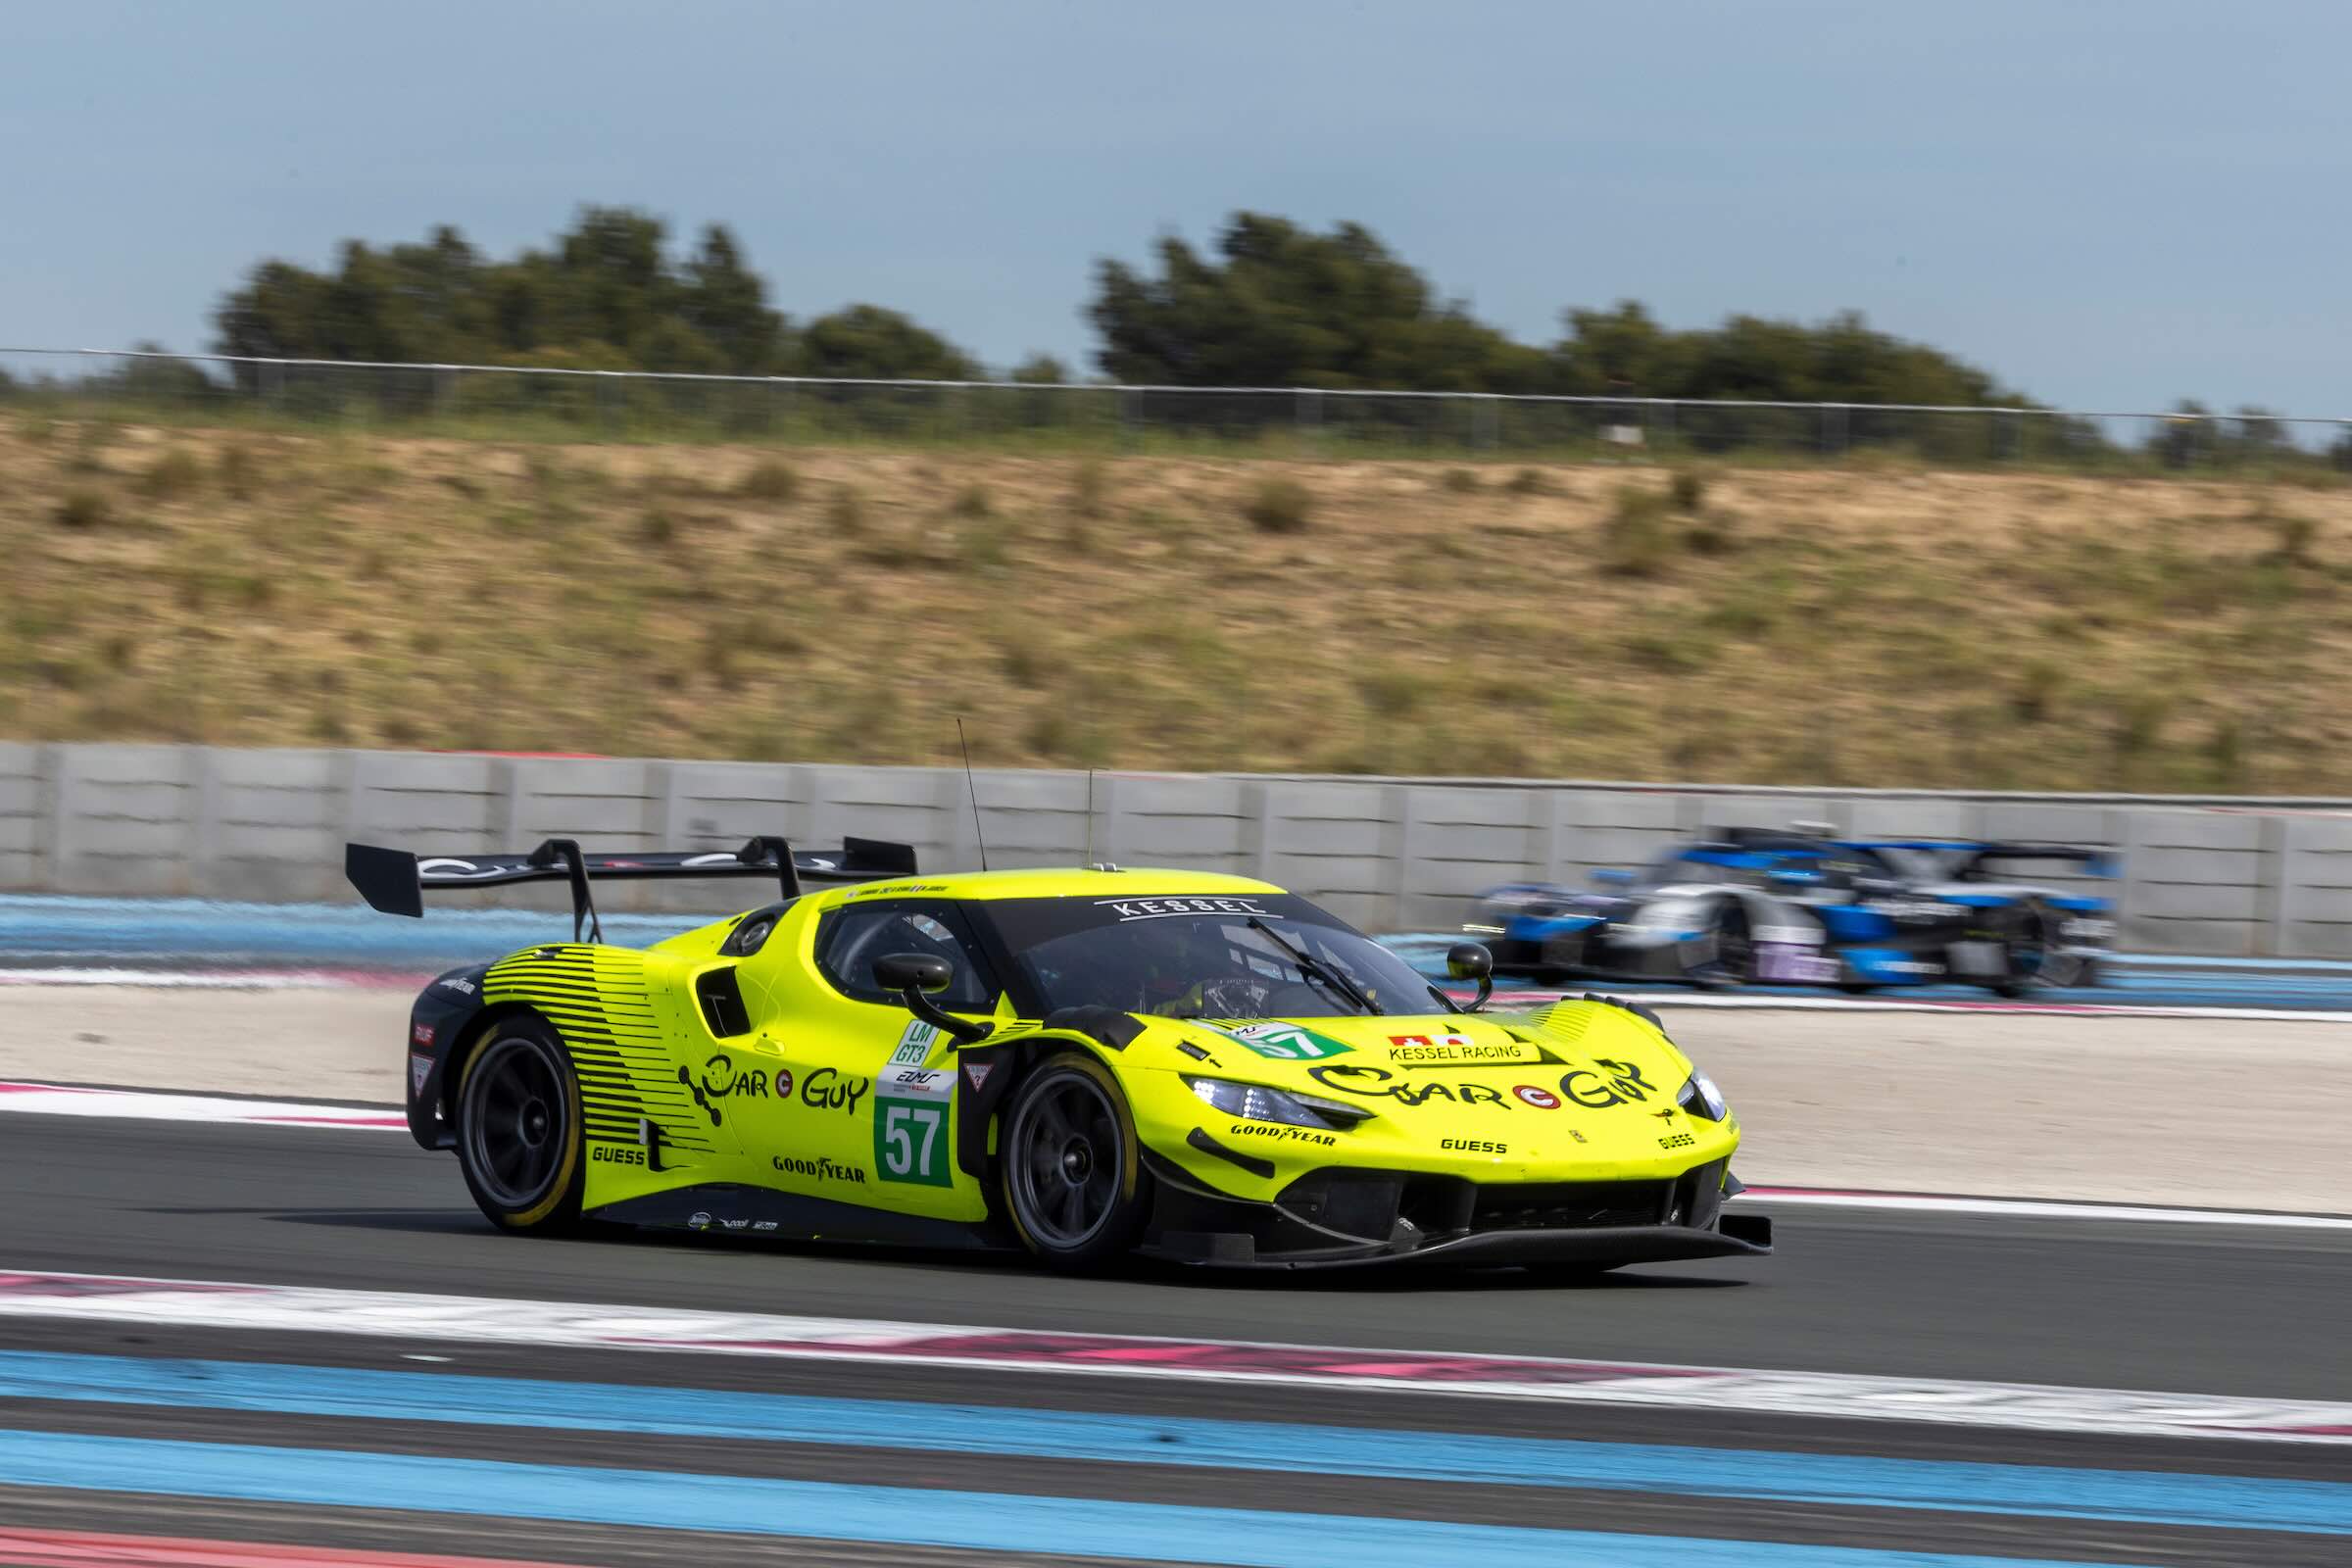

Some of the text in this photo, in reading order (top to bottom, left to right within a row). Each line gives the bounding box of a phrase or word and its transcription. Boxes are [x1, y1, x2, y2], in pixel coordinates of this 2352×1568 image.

[1112, 899, 1267, 916] KESSEL
[909, 1023, 934, 1043] LM
[896, 1045, 926, 1063] GT3
[1389, 1046, 1522, 1060] KESSEL RACING
[886, 1105, 942, 1176] 57
[1441, 1139, 1507, 1153] GUESS
[1658, 1133, 1695, 1150] GUESS
[593, 1147, 645, 1165] GUESS
